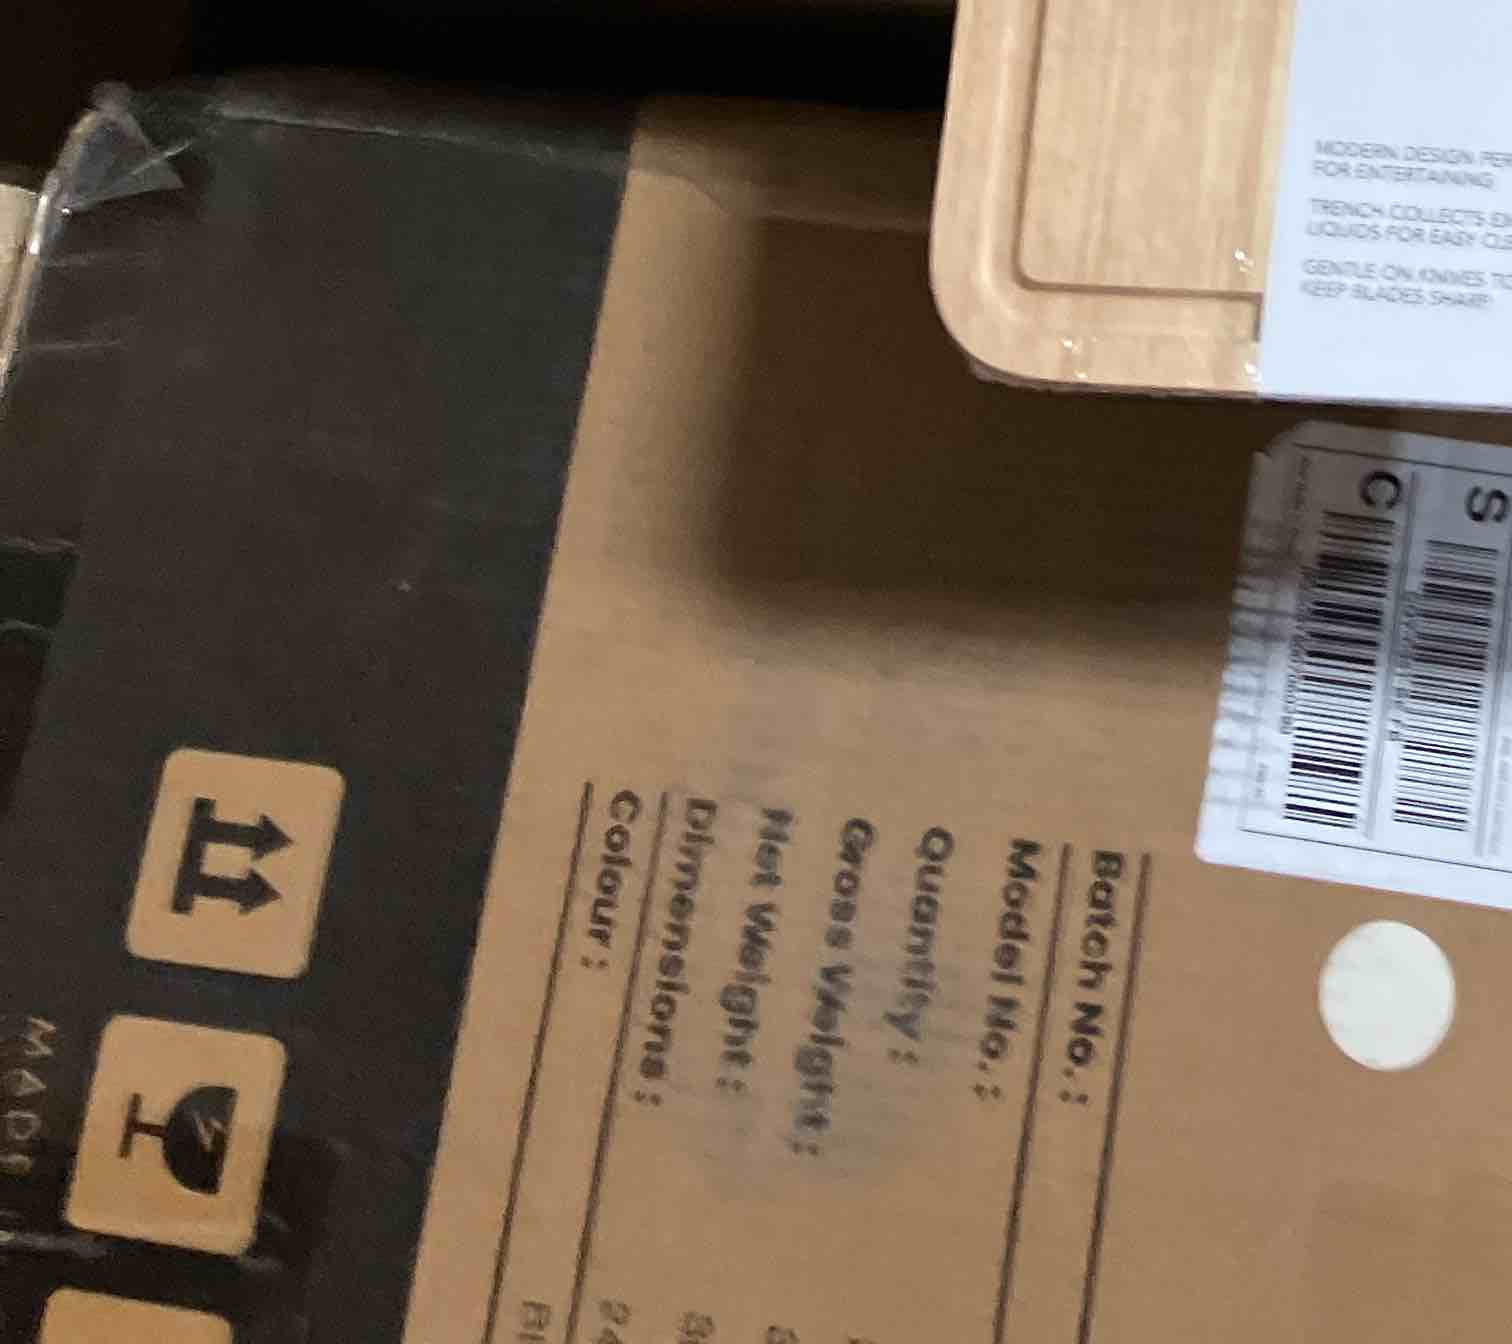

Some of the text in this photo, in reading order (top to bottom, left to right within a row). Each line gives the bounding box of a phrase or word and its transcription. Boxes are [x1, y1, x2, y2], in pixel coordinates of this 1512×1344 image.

[1358, 468, 1404, 512] C
[1464, 485, 1511, 524] S
[750, 807, 793, 887] Net
[824, 816, 875, 951] Gross
[991, 838, 1041, 986] Model
[1077, 849, 1125, 990] Batch
